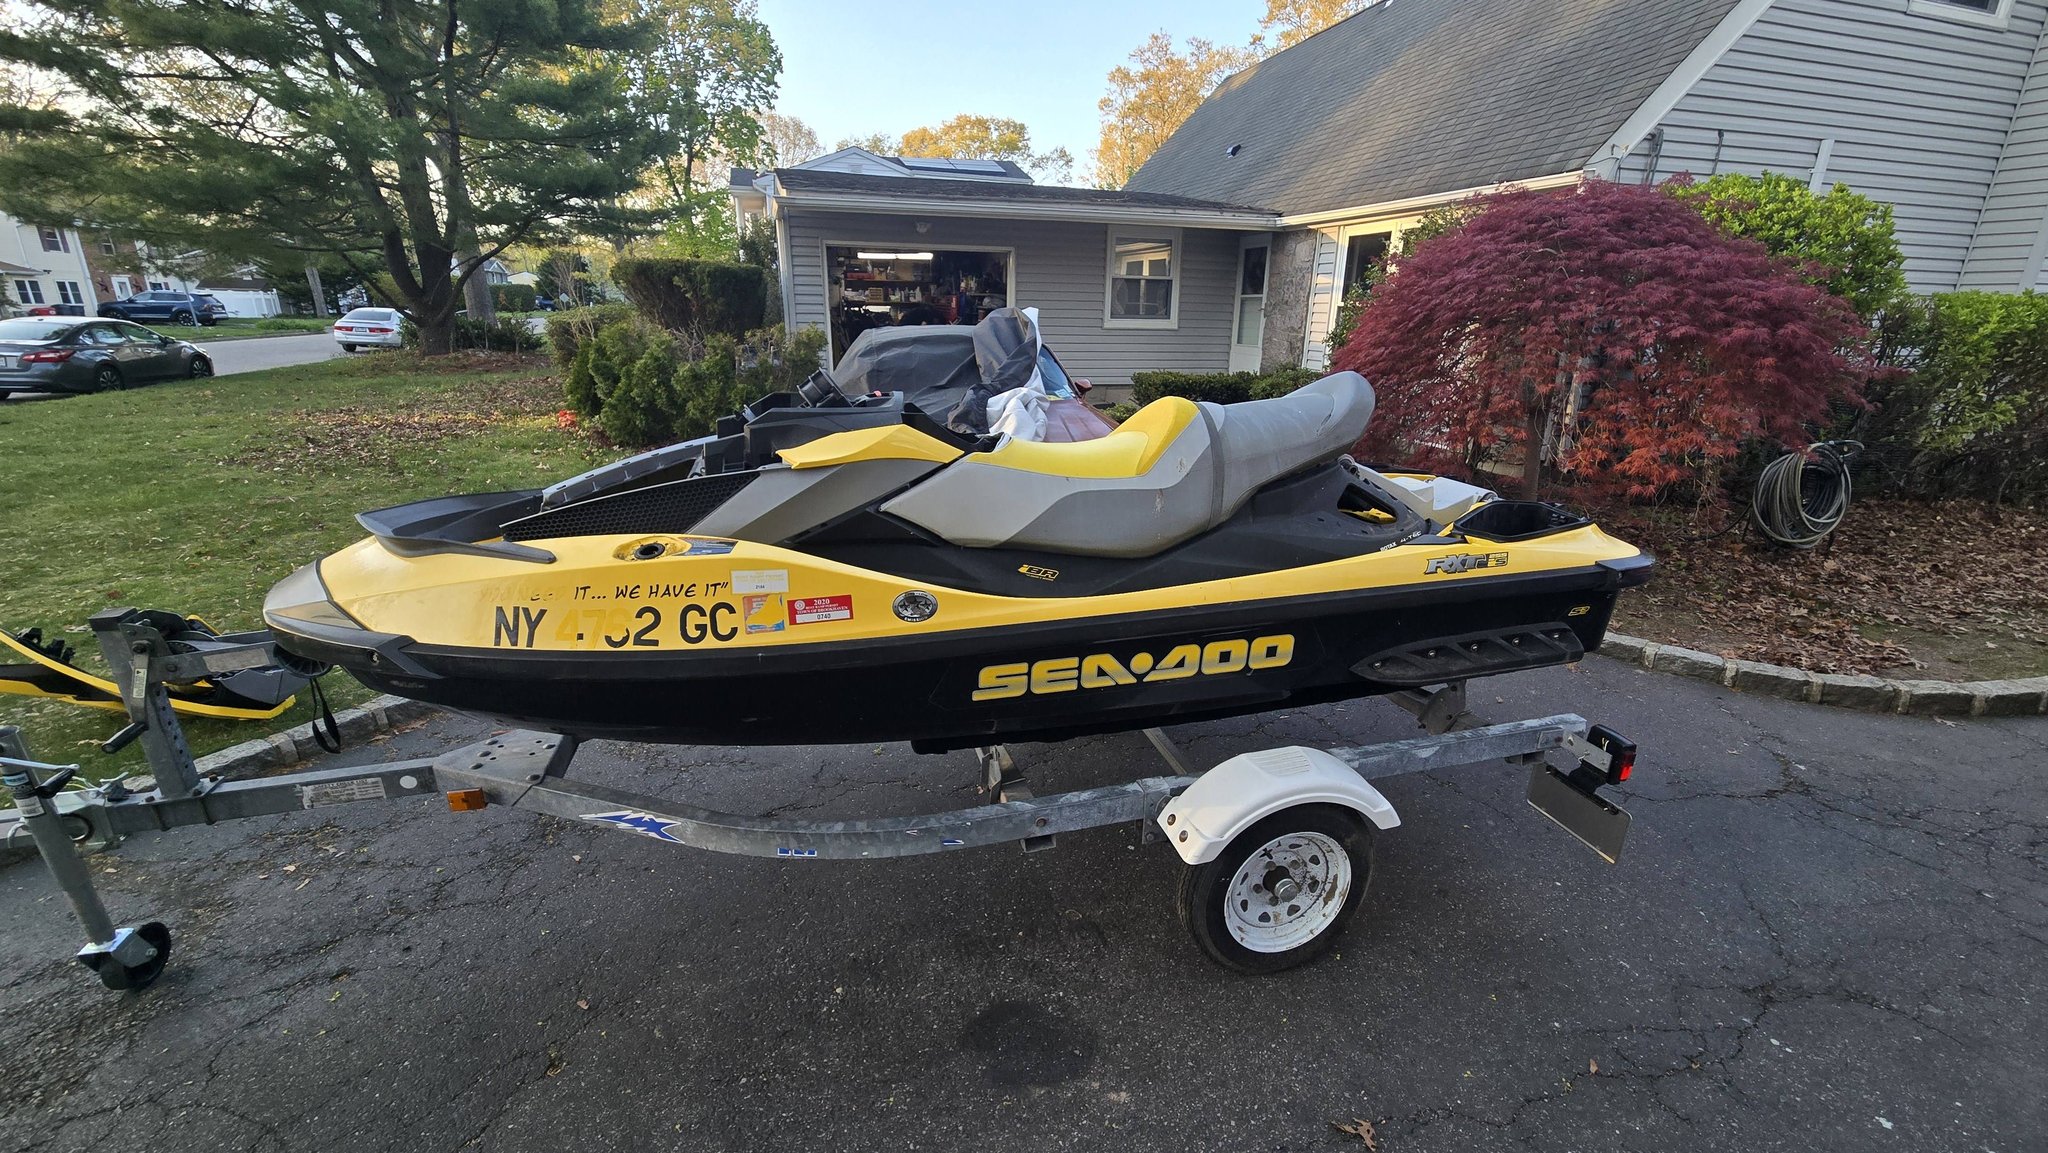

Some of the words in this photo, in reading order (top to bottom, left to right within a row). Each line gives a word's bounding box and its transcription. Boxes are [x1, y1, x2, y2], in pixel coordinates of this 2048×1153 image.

[615, 584, 641, 600] WE
[648, 583, 697, 599] HAVE
[493, 606, 548, 648] NY
[679, 601, 739, 645] GC
